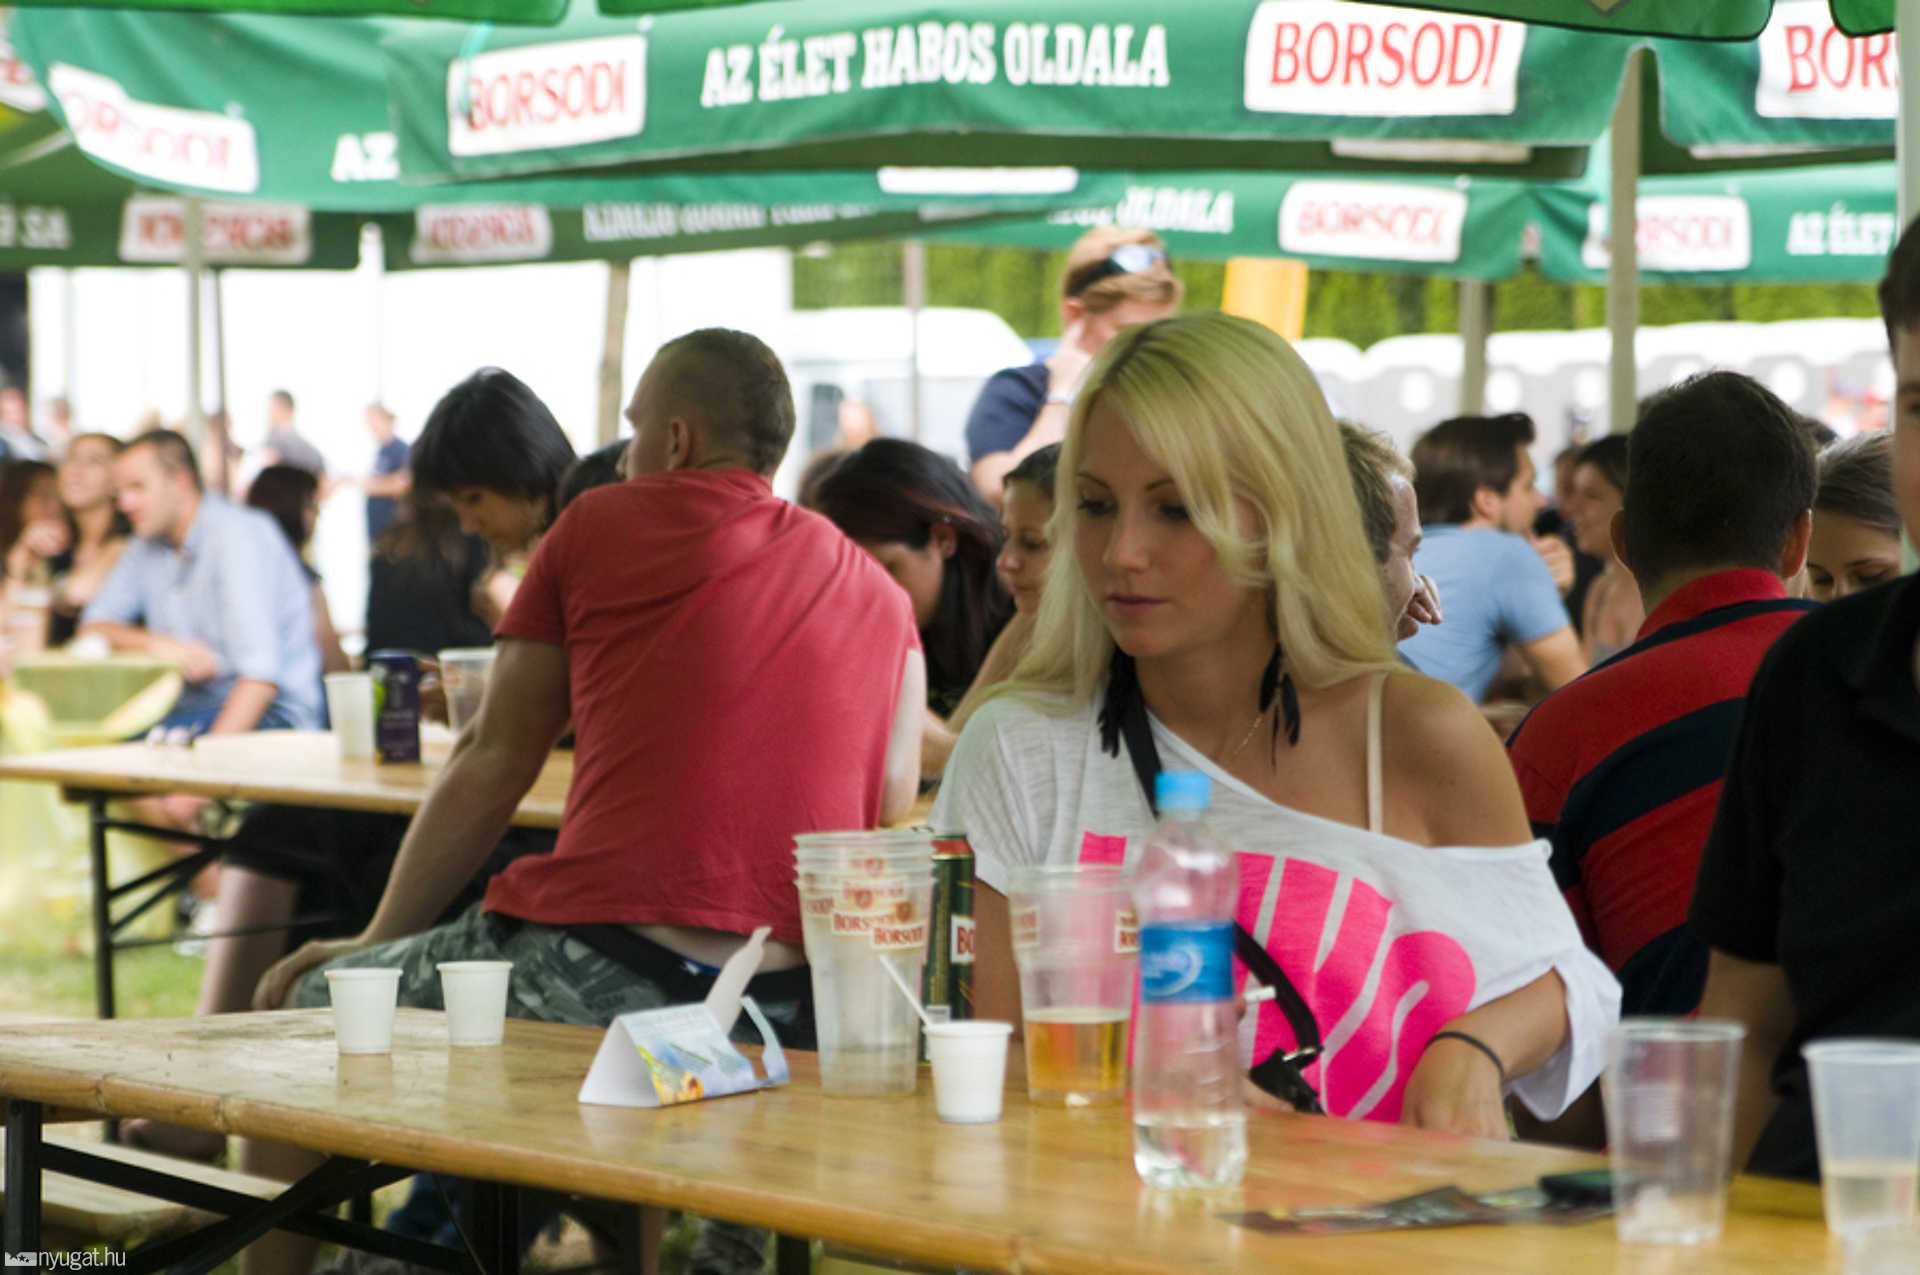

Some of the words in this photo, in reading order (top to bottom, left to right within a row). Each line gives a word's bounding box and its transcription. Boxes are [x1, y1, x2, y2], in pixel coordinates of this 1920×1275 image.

[467, 60, 627, 131] BORSODI
[700, 45, 754, 107] AZ
[758, 24, 856, 100] ÉLET
[861, 22, 977, 88] HABOS
[1003, 23, 1171, 87] OLDALA
[1270, 21, 1501, 87] BORSODI
[1784, 25, 1898, 93] BOR
